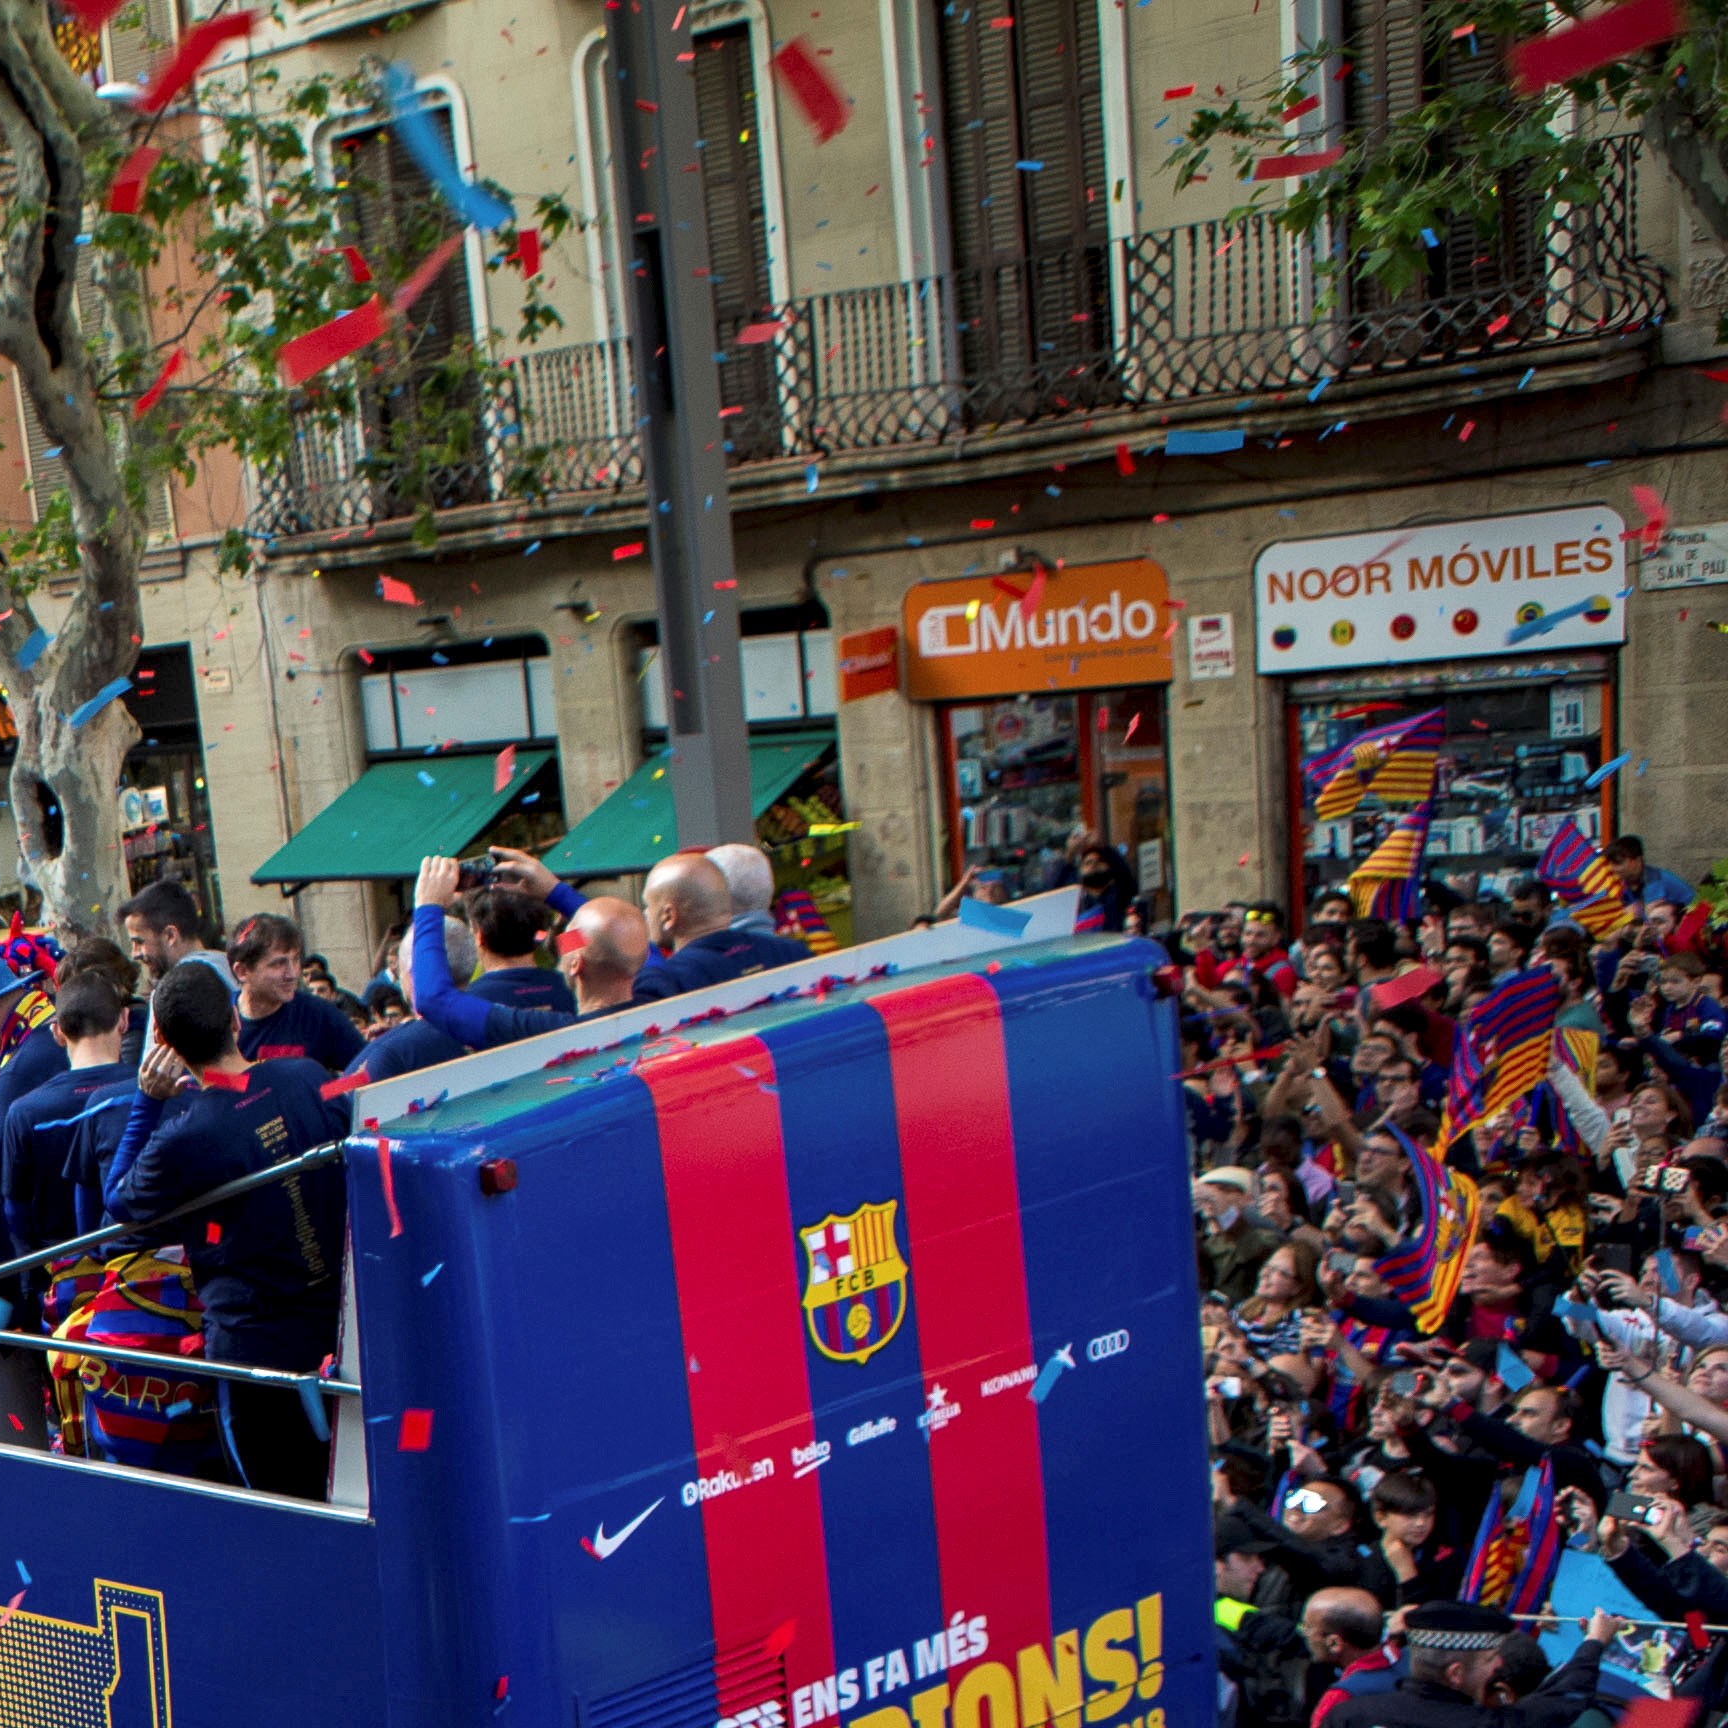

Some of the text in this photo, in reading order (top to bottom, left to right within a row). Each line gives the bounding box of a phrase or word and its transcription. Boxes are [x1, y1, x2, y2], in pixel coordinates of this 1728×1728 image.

[1267, 536, 1614, 605] NOOR MÓVILES
[1658, 559, 1727, 582] SANT PAU
[980, 591, 1157, 653] Mundo
[836, 1268, 876, 1297] FCB
[846, 1416, 897, 1447] Gillette
[791, 1439, 831, 1467] beko
[697, 1455, 775, 1500] Rakuen
[866, 1648, 910, 1701] FA
[913, 1610, 989, 1681] MÉS
